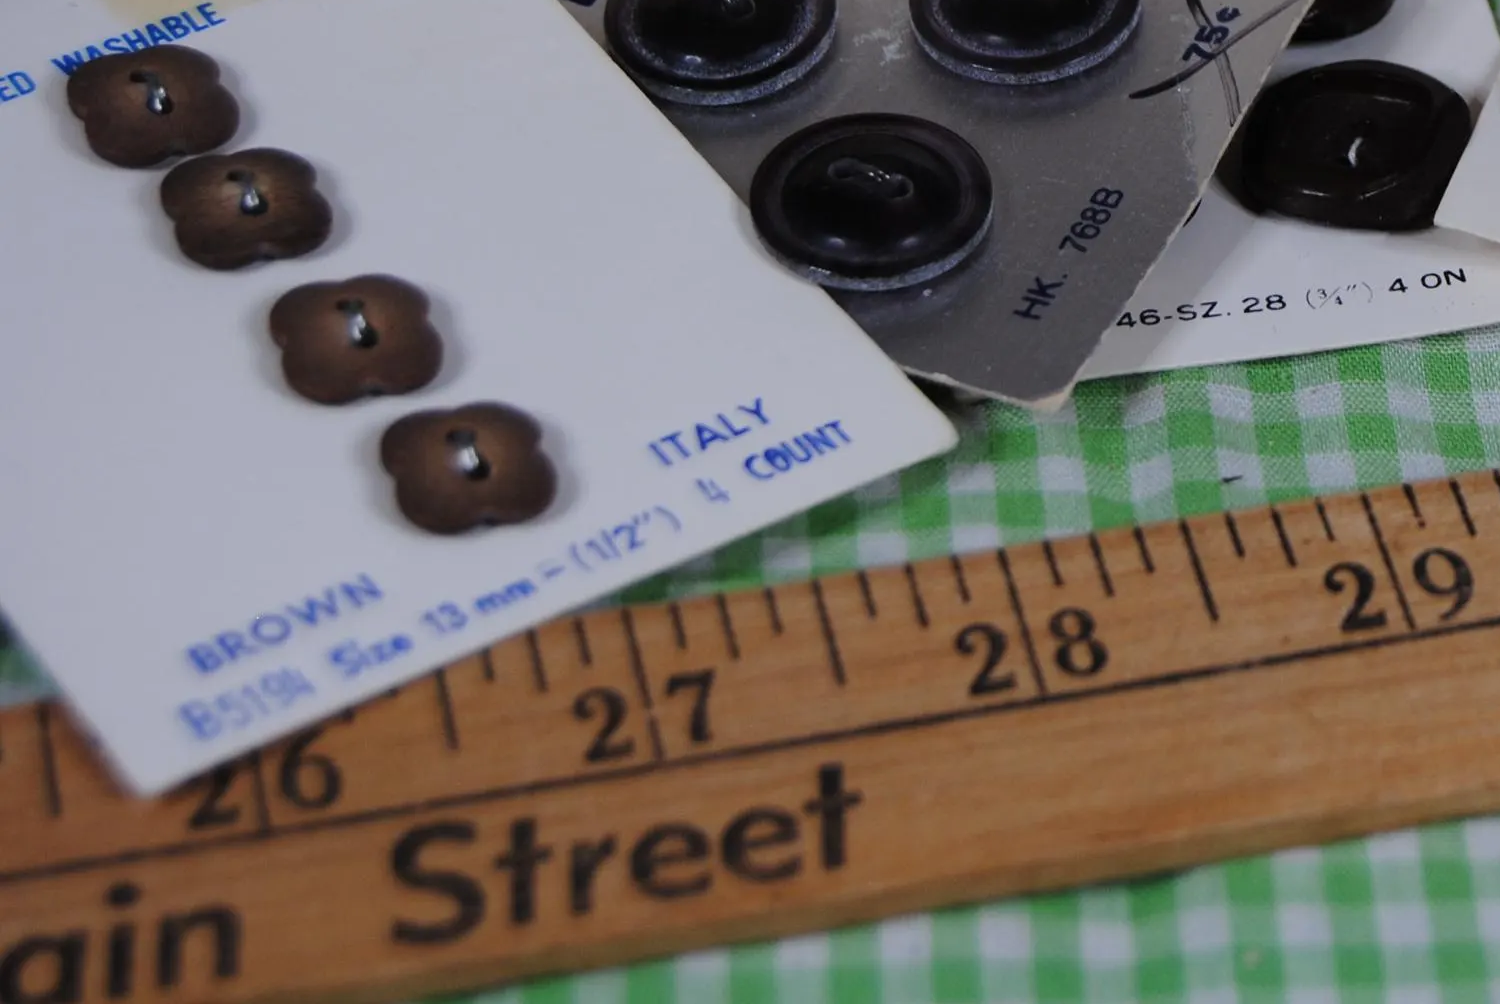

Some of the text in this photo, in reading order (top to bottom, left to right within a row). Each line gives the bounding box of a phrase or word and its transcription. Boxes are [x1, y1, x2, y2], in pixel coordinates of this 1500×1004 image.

[1011, 185, 1125, 322] HK. 768B
[1241, 294, 1288, 315] 28
[1387, 277, 1410, 294] 4
[1420, 267, 1468, 290] ON
[648, 395, 772, 467] ITALY
[328, 632, 414, 678] Size
[420, 600, 469, 634] 13
[473, 578, 538, 613] mm
[695, 477, 732, 504] 4
[742, 418, 853, 481] COUNT
[185, 571, 384, 674] BROWN
[572, 668, 720, 763] 27
[952, 605, 1112, 698] 28
[1323, 545, 1476, 634] 29
[388, 761, 863, 949] Street
